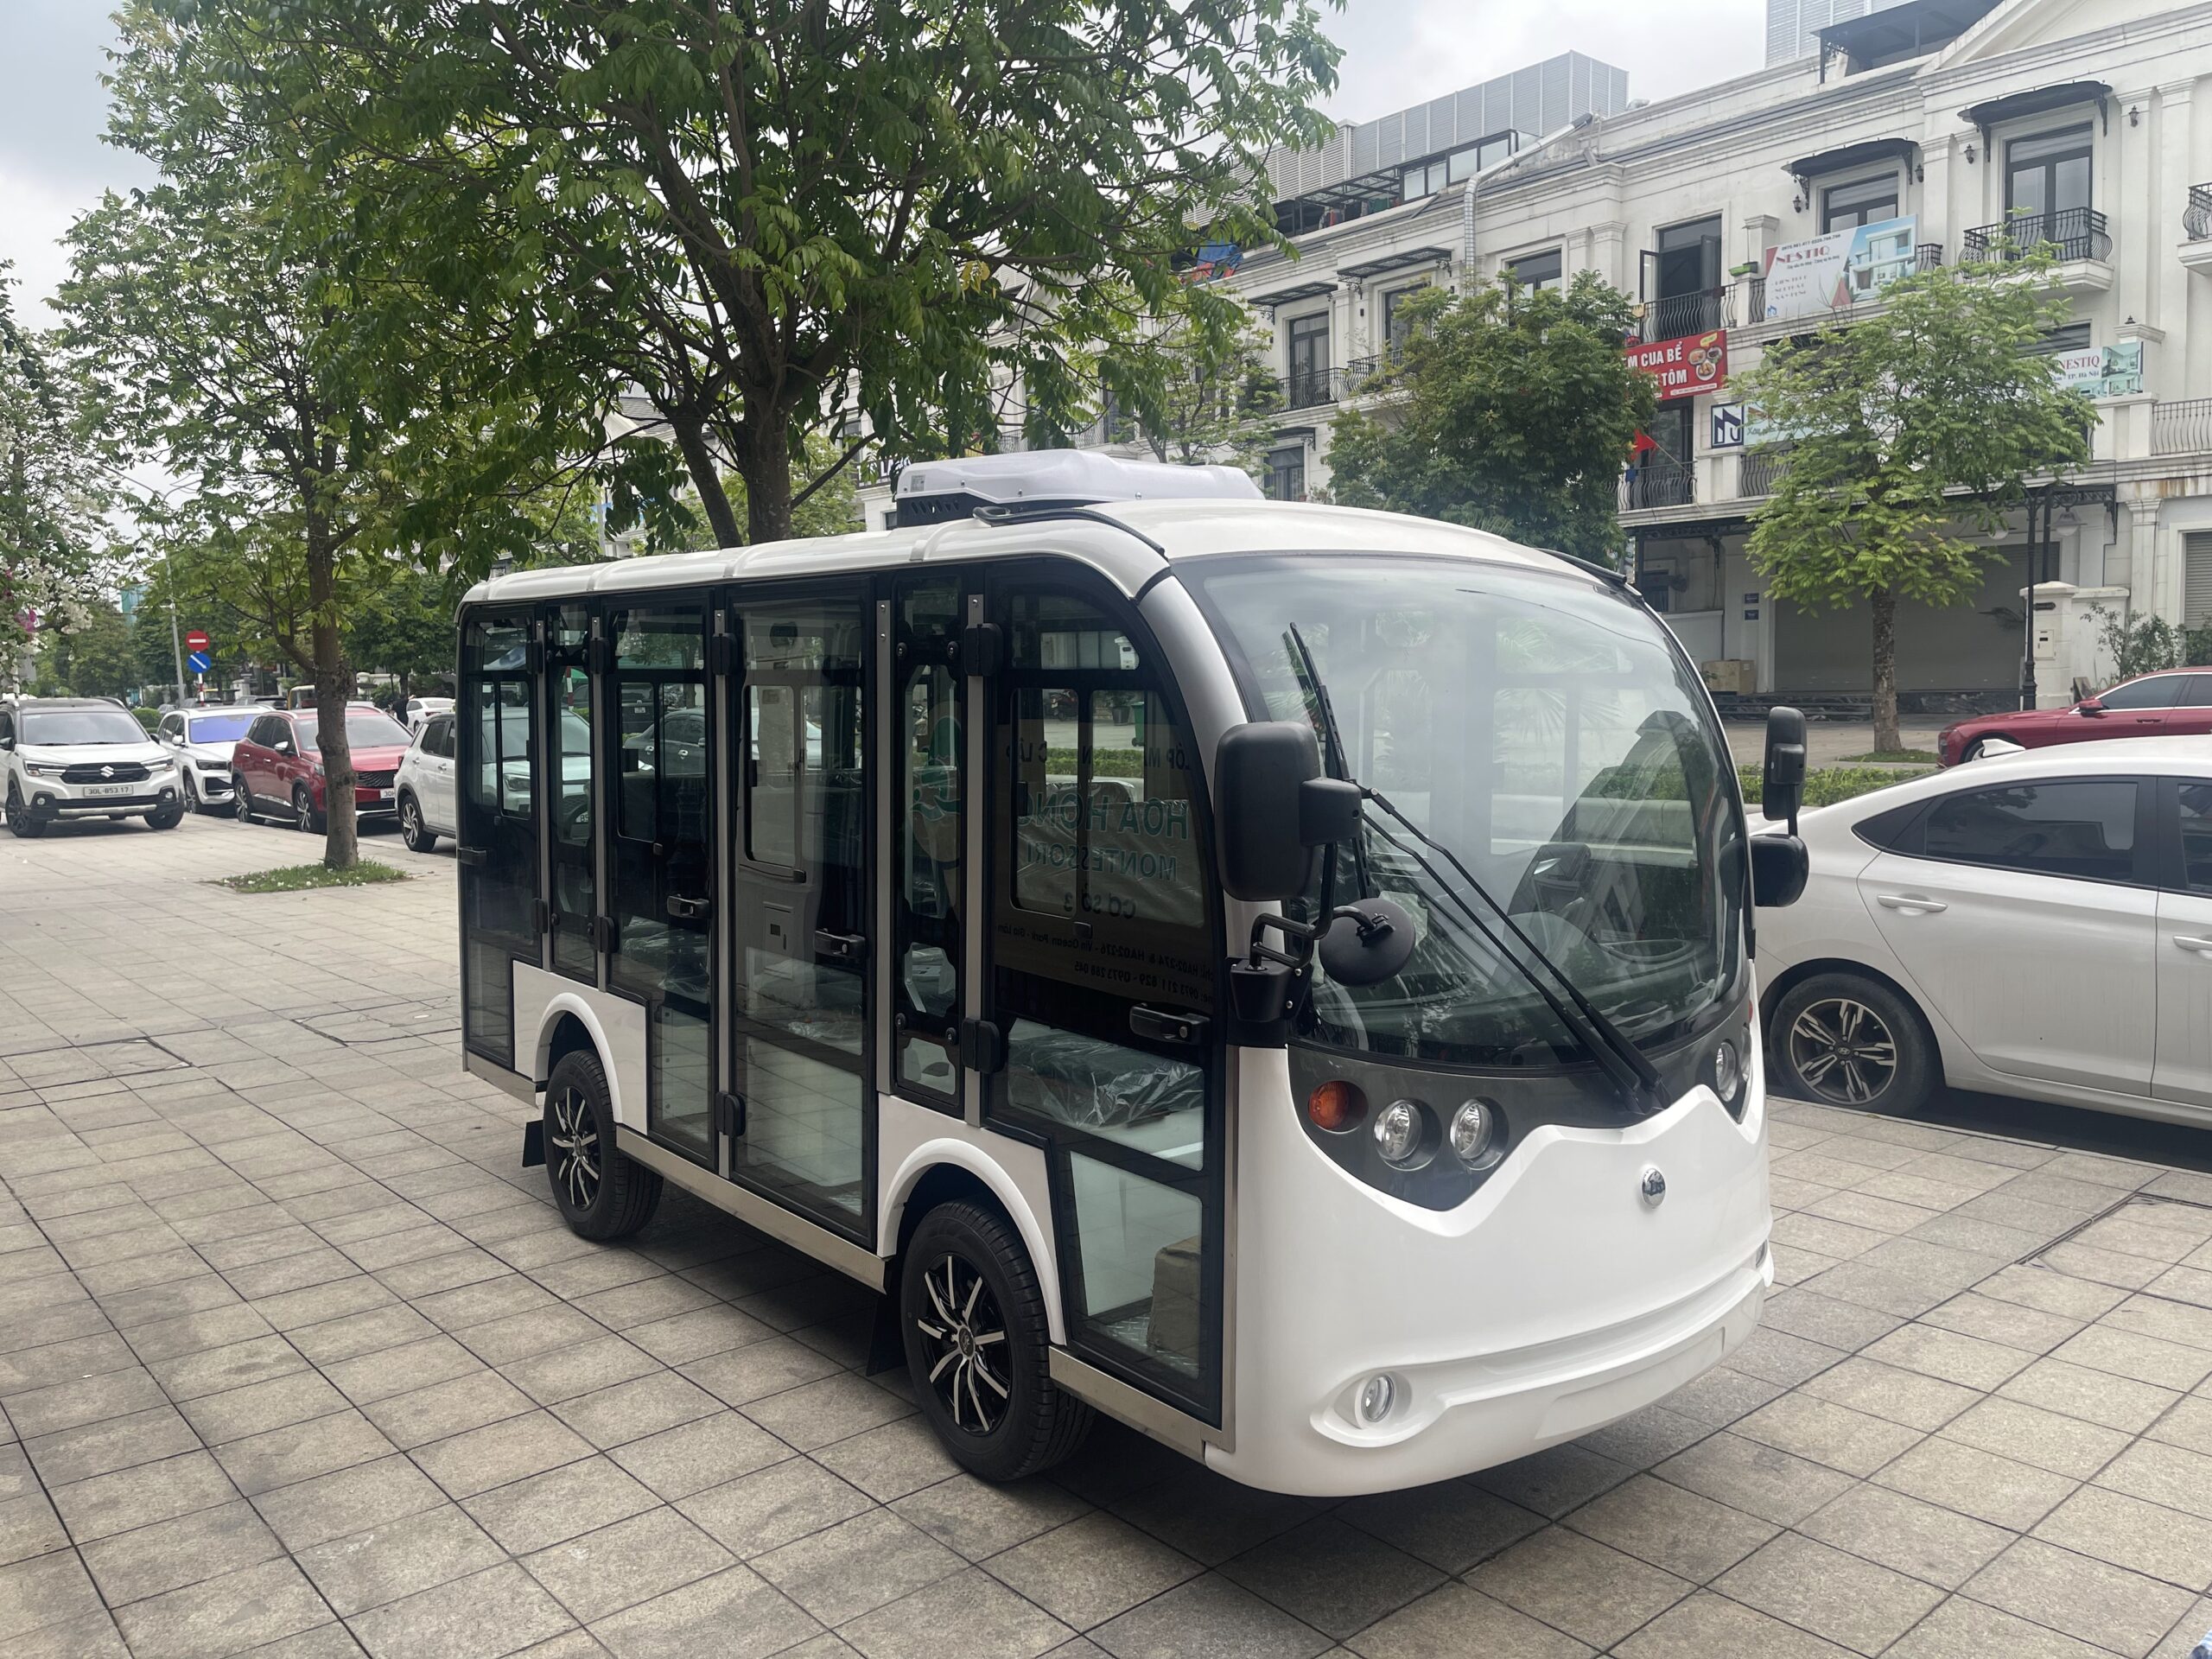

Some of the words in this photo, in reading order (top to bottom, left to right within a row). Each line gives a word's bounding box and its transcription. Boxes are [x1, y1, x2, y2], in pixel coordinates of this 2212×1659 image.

[1641, 350, 1664, 367] CUA
[1667, 340, 1683, 363] BỂ
[2059, 355, 2100, 370] NESTIQ
[1662, 368, 1688, 387] TÔM
